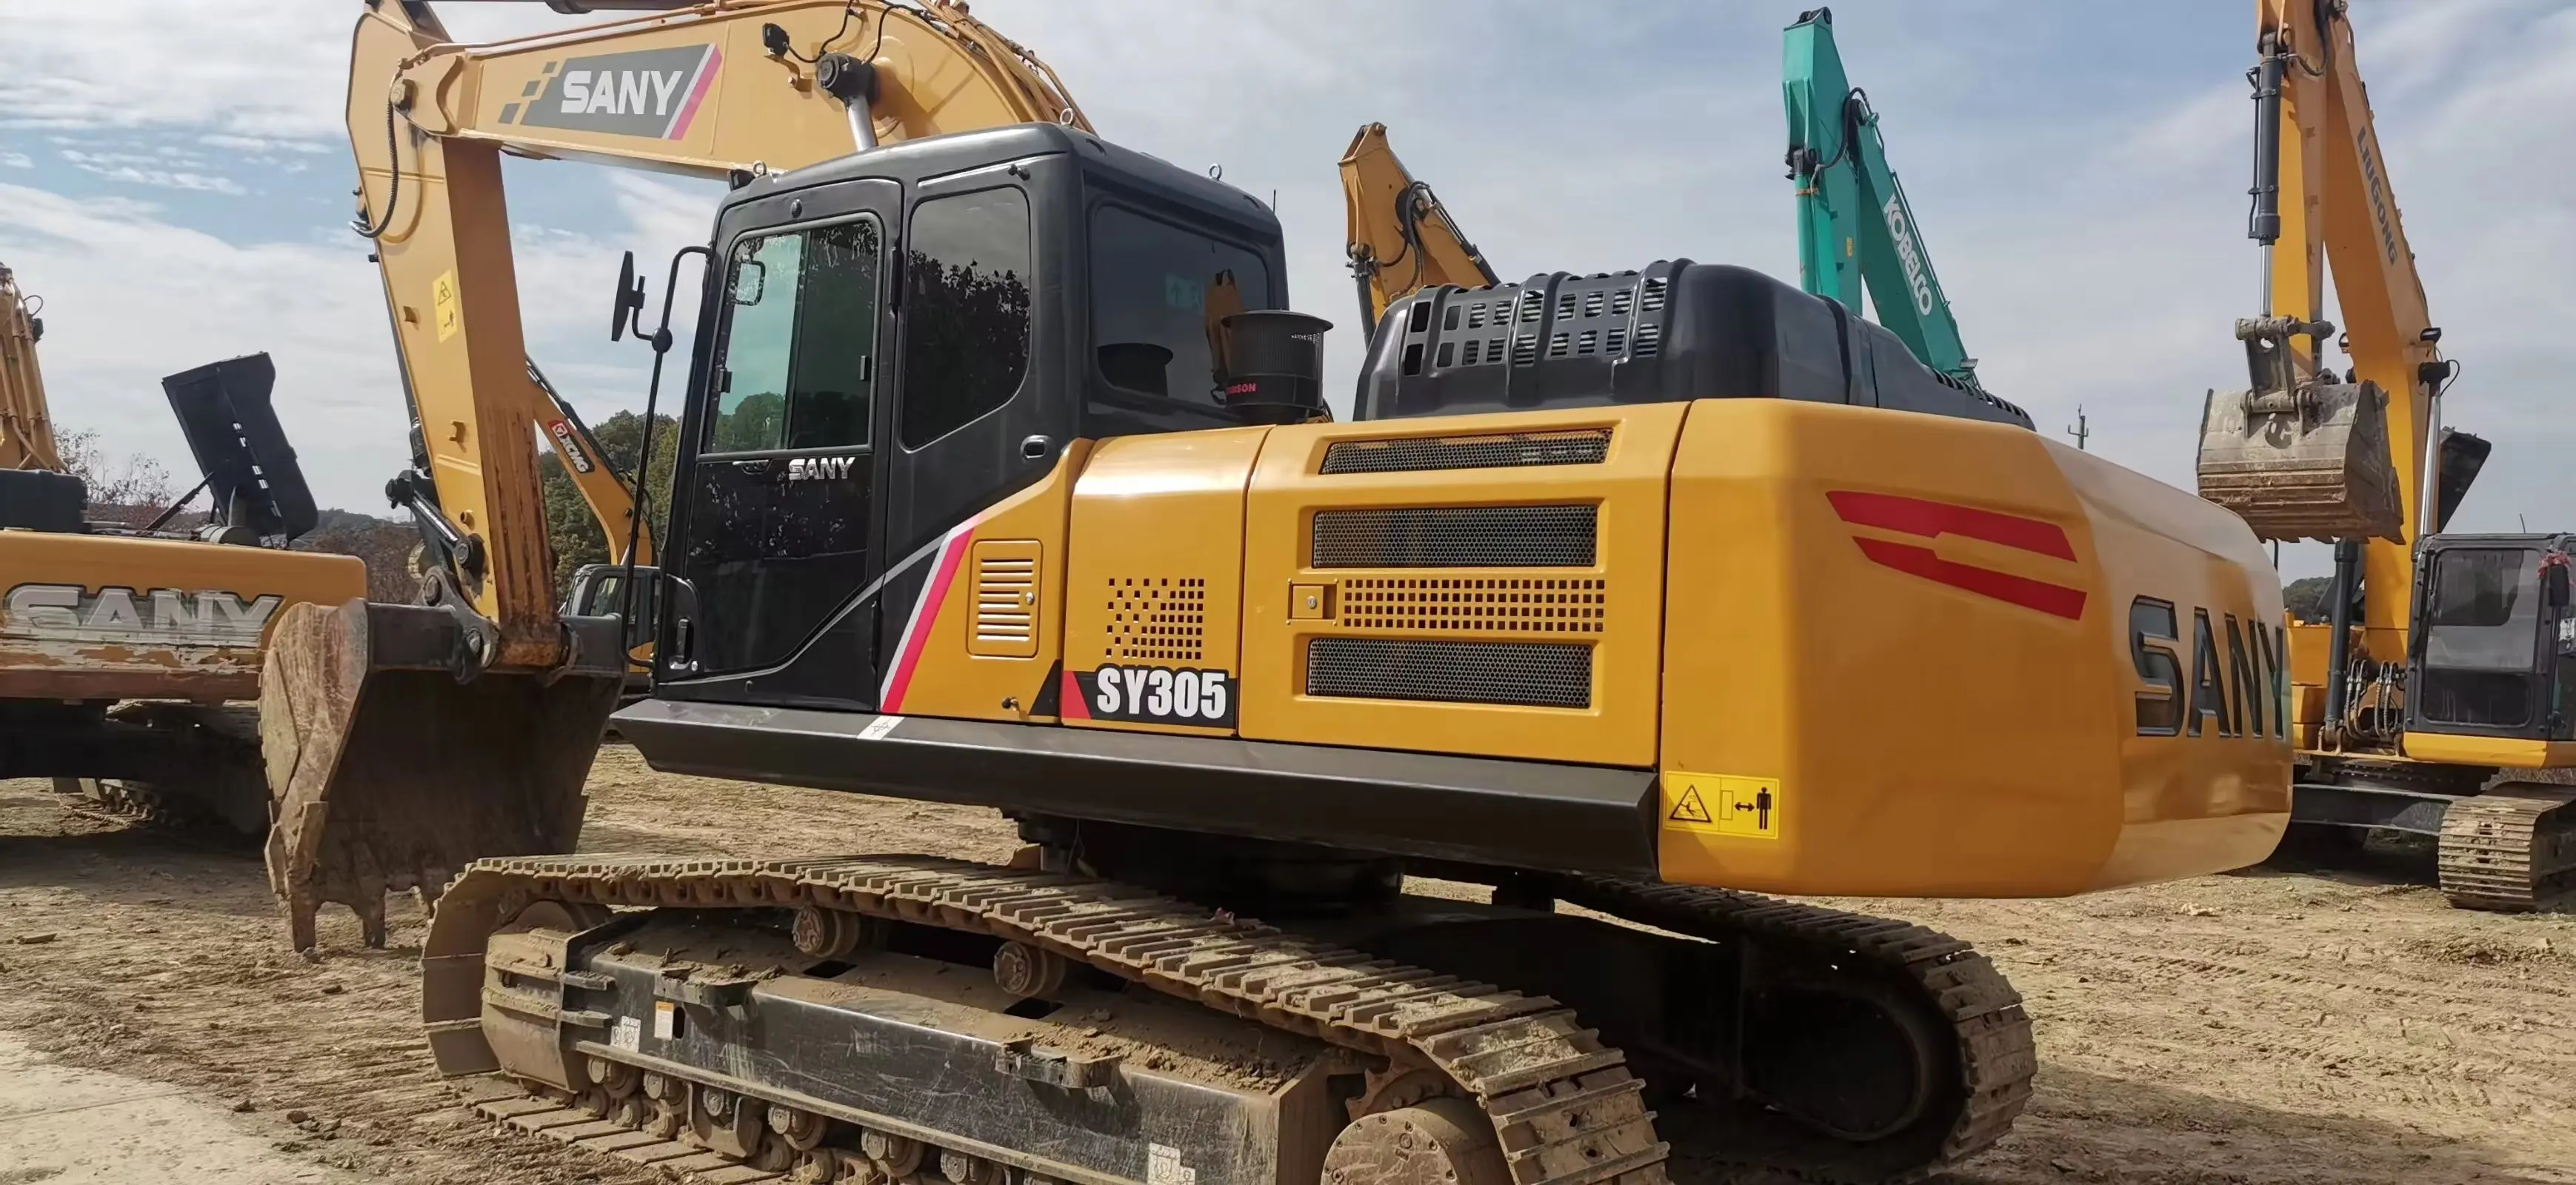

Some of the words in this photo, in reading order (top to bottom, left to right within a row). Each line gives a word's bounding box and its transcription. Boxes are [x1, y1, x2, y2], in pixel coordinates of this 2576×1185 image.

[561, 70, 684, 116] SANY
[2357, 125, 2398, 266] LIUGONG
[1883, 193, 1932, 316] KOBELCO
[789, 456, 855, 481] SANY
[6, 583, 285, 632] SANY
[2129, 594, 2284, 738] SANY
[1097, 667, 1227, 719] SY305
